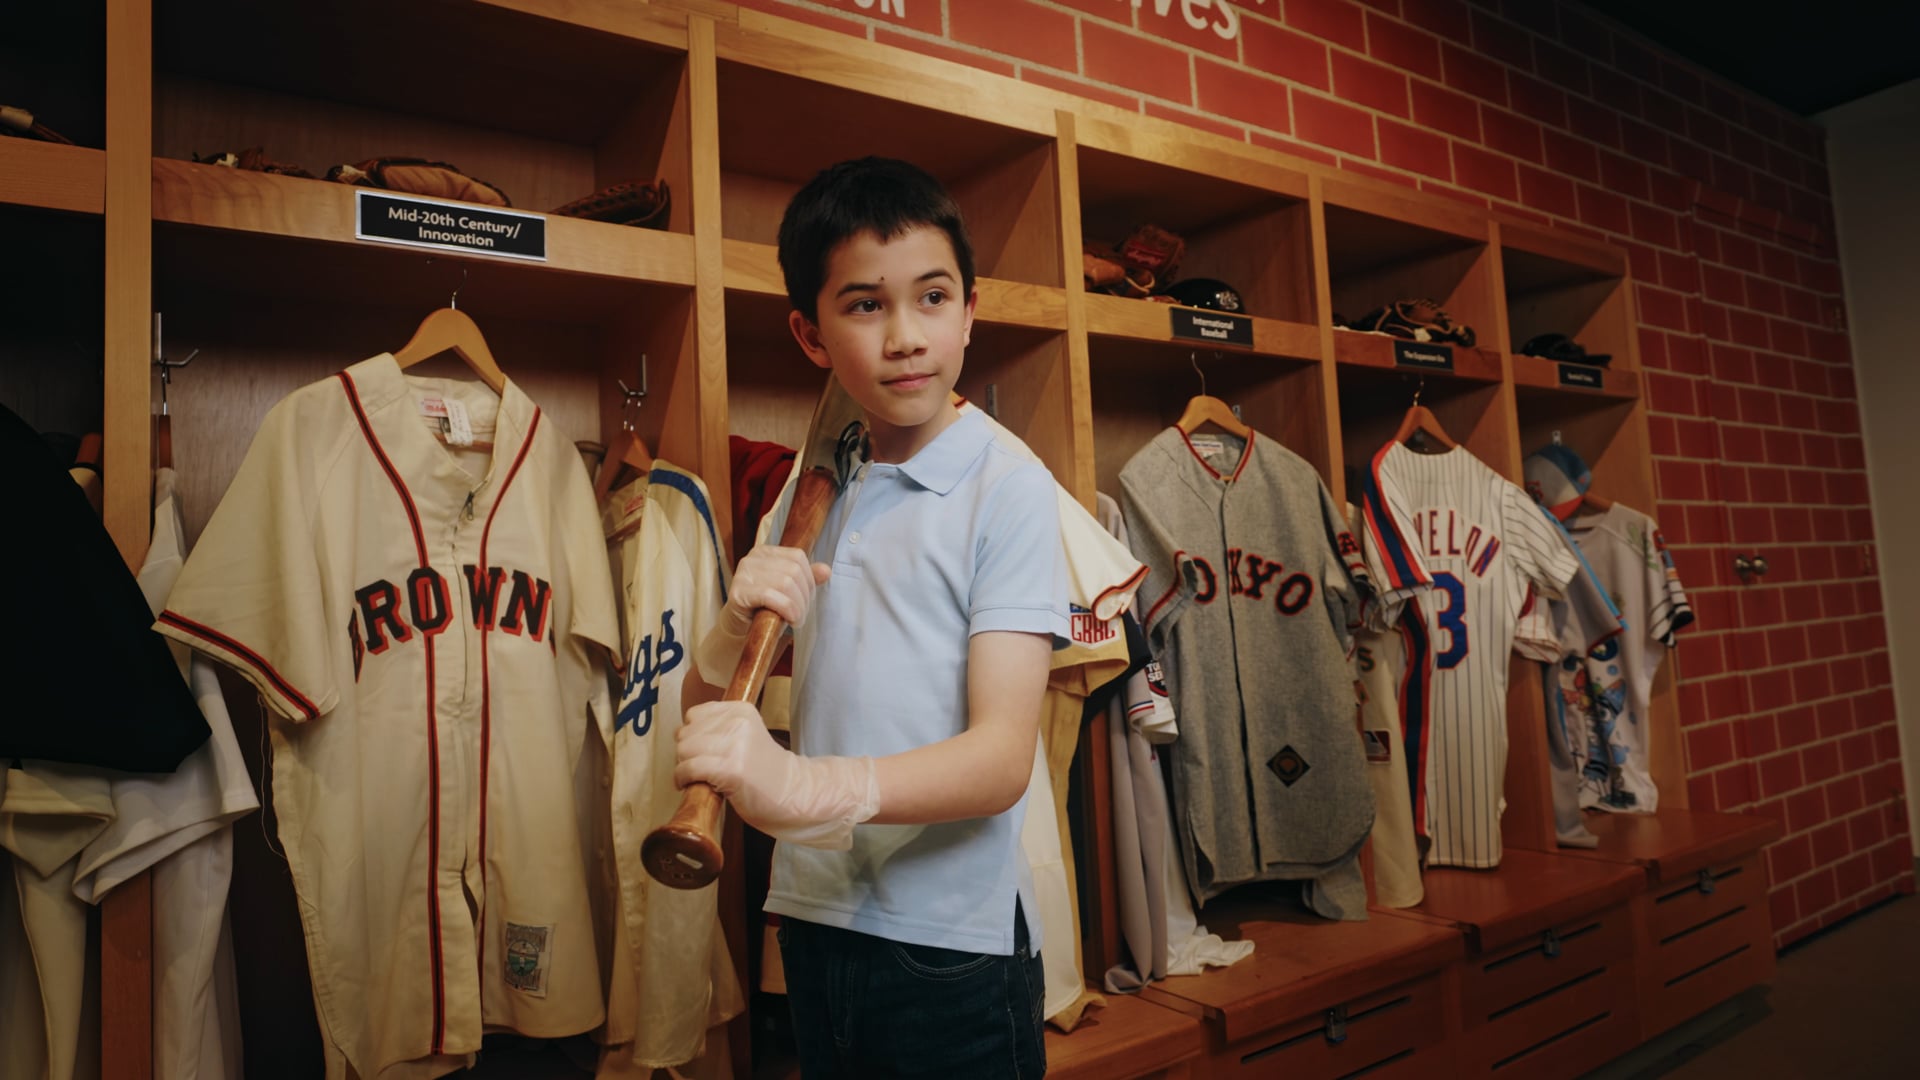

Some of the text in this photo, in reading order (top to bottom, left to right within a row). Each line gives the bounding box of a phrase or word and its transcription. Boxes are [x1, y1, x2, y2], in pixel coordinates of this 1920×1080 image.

[388, 207, 521, 239] Mid-20th Century/
[418, 227, 494, 248] Innovation
[1430, 571, 1469, 670] 3
